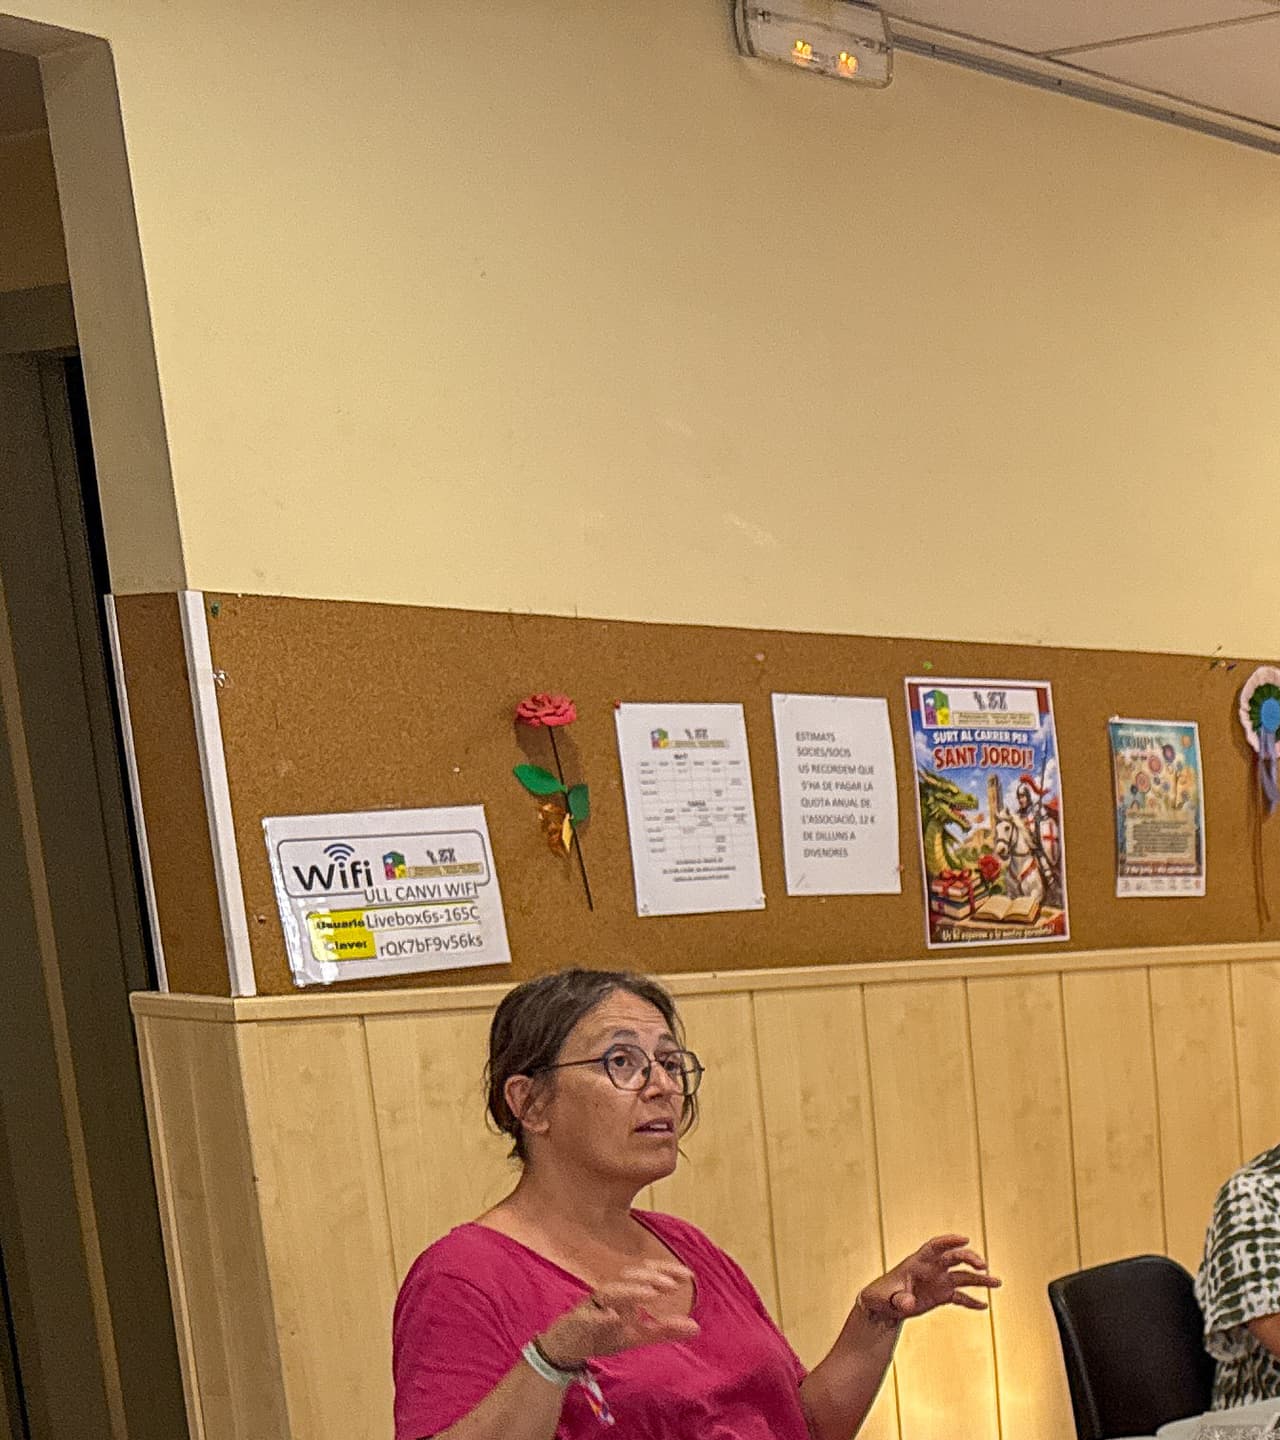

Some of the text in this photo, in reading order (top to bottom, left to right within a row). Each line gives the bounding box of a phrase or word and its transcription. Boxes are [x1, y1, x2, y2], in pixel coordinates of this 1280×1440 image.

[933, 731, 959, 745] SURT
[961, 730, 974, 742] AL
[975, 730, 1010, 744] CARRER
[934, 746, 1035, 771] SANT JORDI!
[799, 764, 874, 776] US RECORDEM QUE
[822, 780, 833, 791] DE
[835, 780, 862, 791] PAGAR
[863, 780, 874, 791] LA
[801, 798, 831, 809] QUOTA
[832, 798, 858, 809] ANUAL
[860, 815, 869, 825] 12
[803, 831, 856, 842] DE DILLUNS A
[293, 860, 373, 891] Wifi
[364, 881, 478, 904] ULL CANVI WIFI
